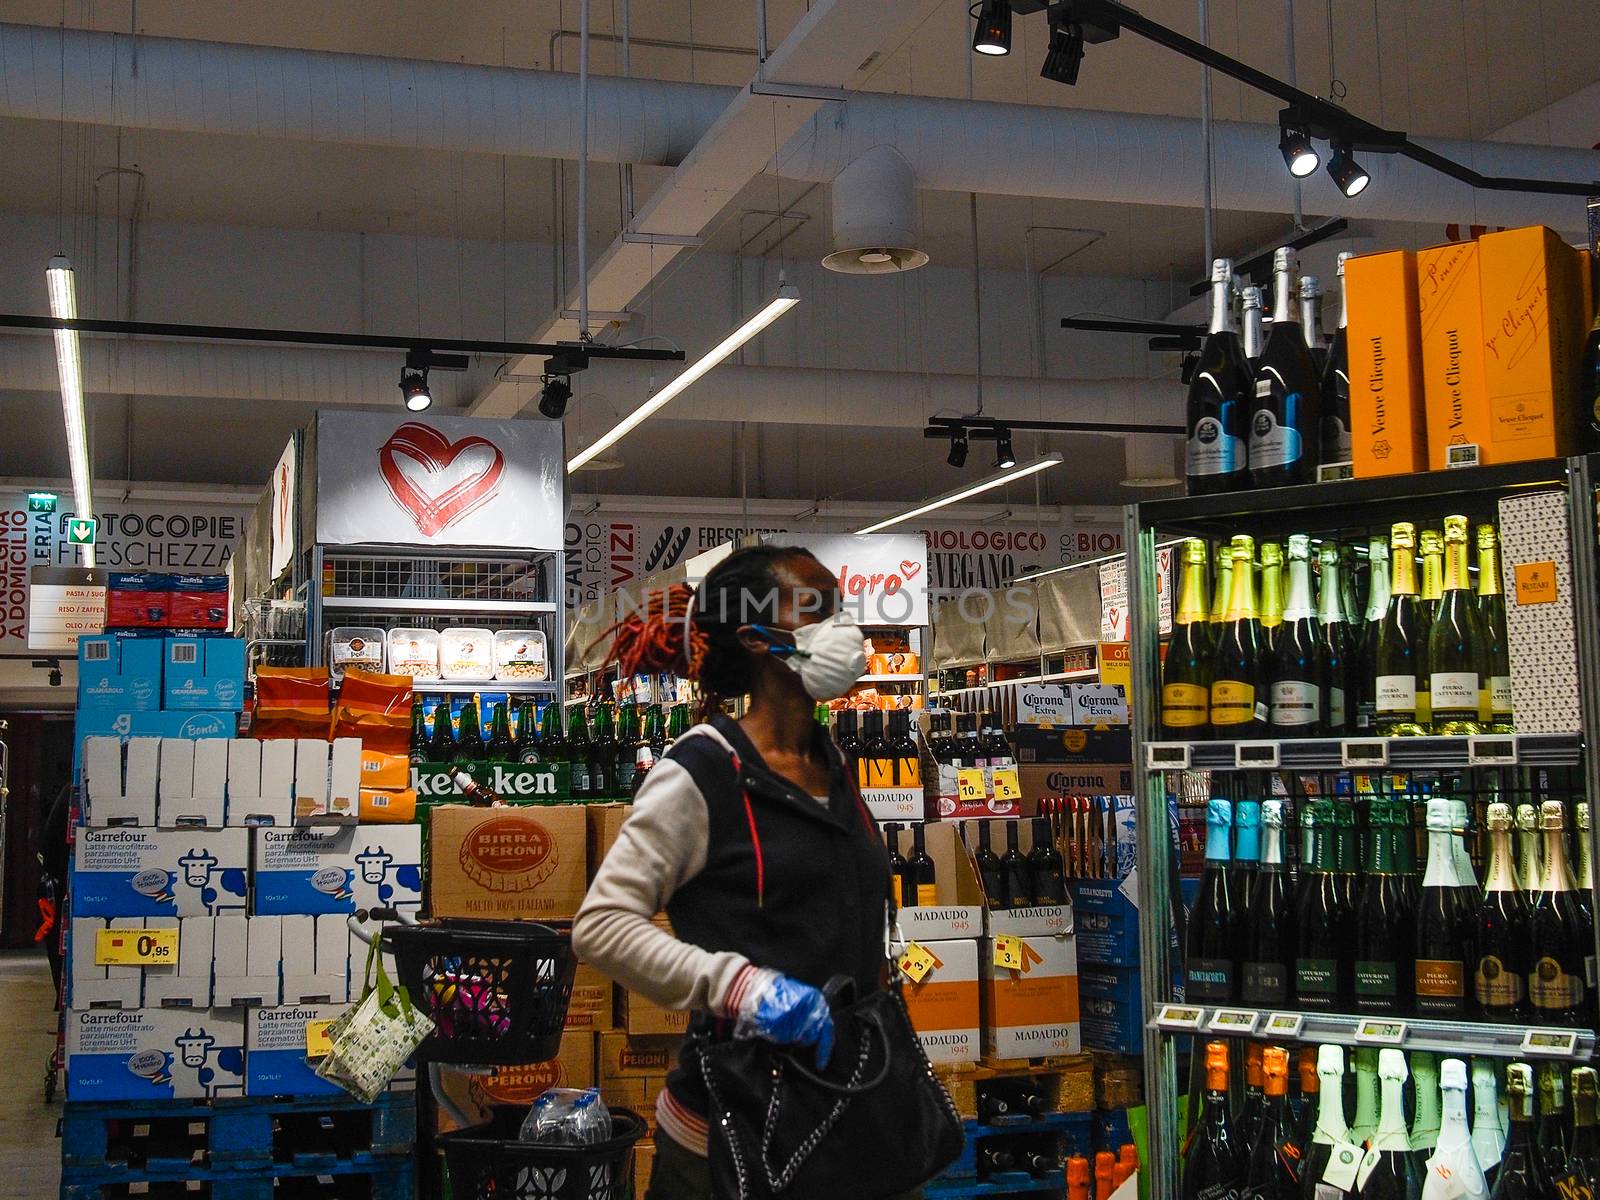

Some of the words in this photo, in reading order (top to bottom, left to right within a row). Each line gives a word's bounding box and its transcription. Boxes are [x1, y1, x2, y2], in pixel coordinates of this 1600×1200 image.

[1446, 329, 1462, 386] Clicquot
[1370, 337, 1386, 392] Clicquot
[1371, 394, 1386, 435] Veuve
[1449, 390, 1463, 429] Veuve
[59, 512, 235, 538] FTOCOPIE
[586, 523, 601, 573] FOTO
[610, 524, 634, 588] VIZI
[9, 510, 27, 621] DOMICILIO
[935, 553, 1014, 589] VEGANO
[86, 573, 93, 582] 4
[9, 626, 26, 640] A
[1023, 693, 1064, 708] Corona
[1078, 694, 1119, 708] Corona
[1035, 707, 1056, 715] Extra
[1090, 707, 1112, 715] Extra
[489, 766, 557, 795] ken
[1046, 771, 1105, 793] Corona
[962, 786, 974, 796] 10
[1003, 786, 1010, 796] 5
[862, 794, 913, 802] MADAUDO
[85, 831, 147, 842] Carrefour
[264, 830, 324, 841] Carrefour
[478, 834, 542, 844] BIRRA
[286, 842, 335, 850] microfiltrato
[478, 846, 543, 857] PERONI
[466, 900, 494, 912] MALTO
[517, 899, 556, 911] ITALIANO
[914, 911, 969, 921] MADAUDO
[1008, 908, 1062, 918] MADAUDO
[951, 921, 969, 930] 1945
[137, 935, 169, 957] 0,95
[1004, 953, 1011, 963] 3
[914, 961, 924, 971] 3
[80, 1012, 143, 1024] Carrefour
[258, 1009, 318, 1021] Carrefour
[103, 1024, 154, 1032] microfiltrato
[80, 1032, 133, 1040] parzialmente
[1015, 1029, 1069, 1039] MADAUDO
[120, 1038, 138, 1046] UHT
[951, 1046, 969, 1055] 1945
[623, 1055, 666, 1066] PERONI
[487, 1074, 553, 1086] PERONI
